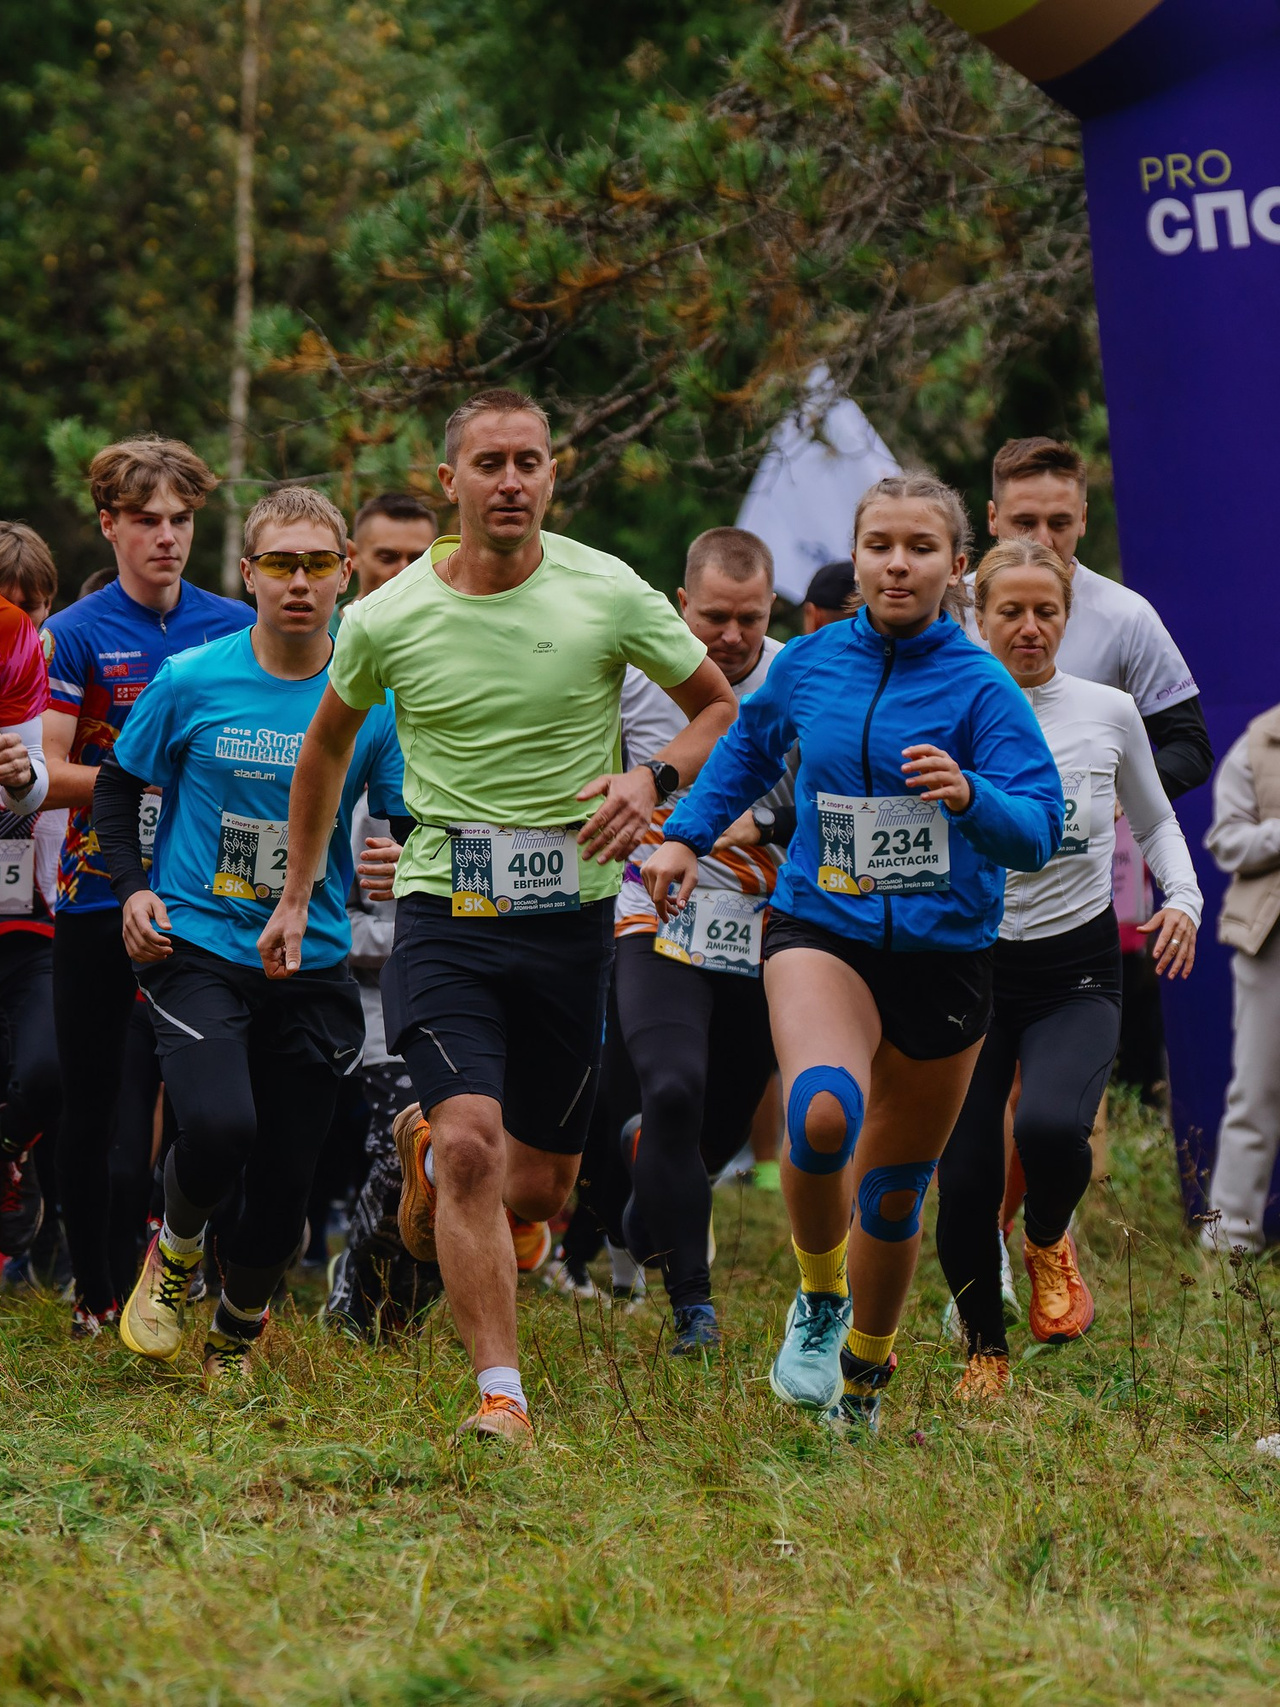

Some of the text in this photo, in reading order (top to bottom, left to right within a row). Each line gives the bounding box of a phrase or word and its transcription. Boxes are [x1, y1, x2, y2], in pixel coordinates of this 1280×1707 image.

[1140, 149, 1232, 193] PRO
[1147, 186, 1280, 255] СПО
[223, 727, 251, 736] 2012
[234, 769, 276, 781] stadium
[827, 801, 845, 809] СПОРТ
[231, 820, 251, 829] СПОРТ
[871, 827, 933, 856] 234
[507, 850, 564, 877] 400
[867, 854, 939, 868] АНАСТАСИЯ
[513, 875, 562, 889] ЕВГЕНИЙ
[706, 919, 751, 944] 624
[705, 941, 750, 955] ДМИТРИЙ
